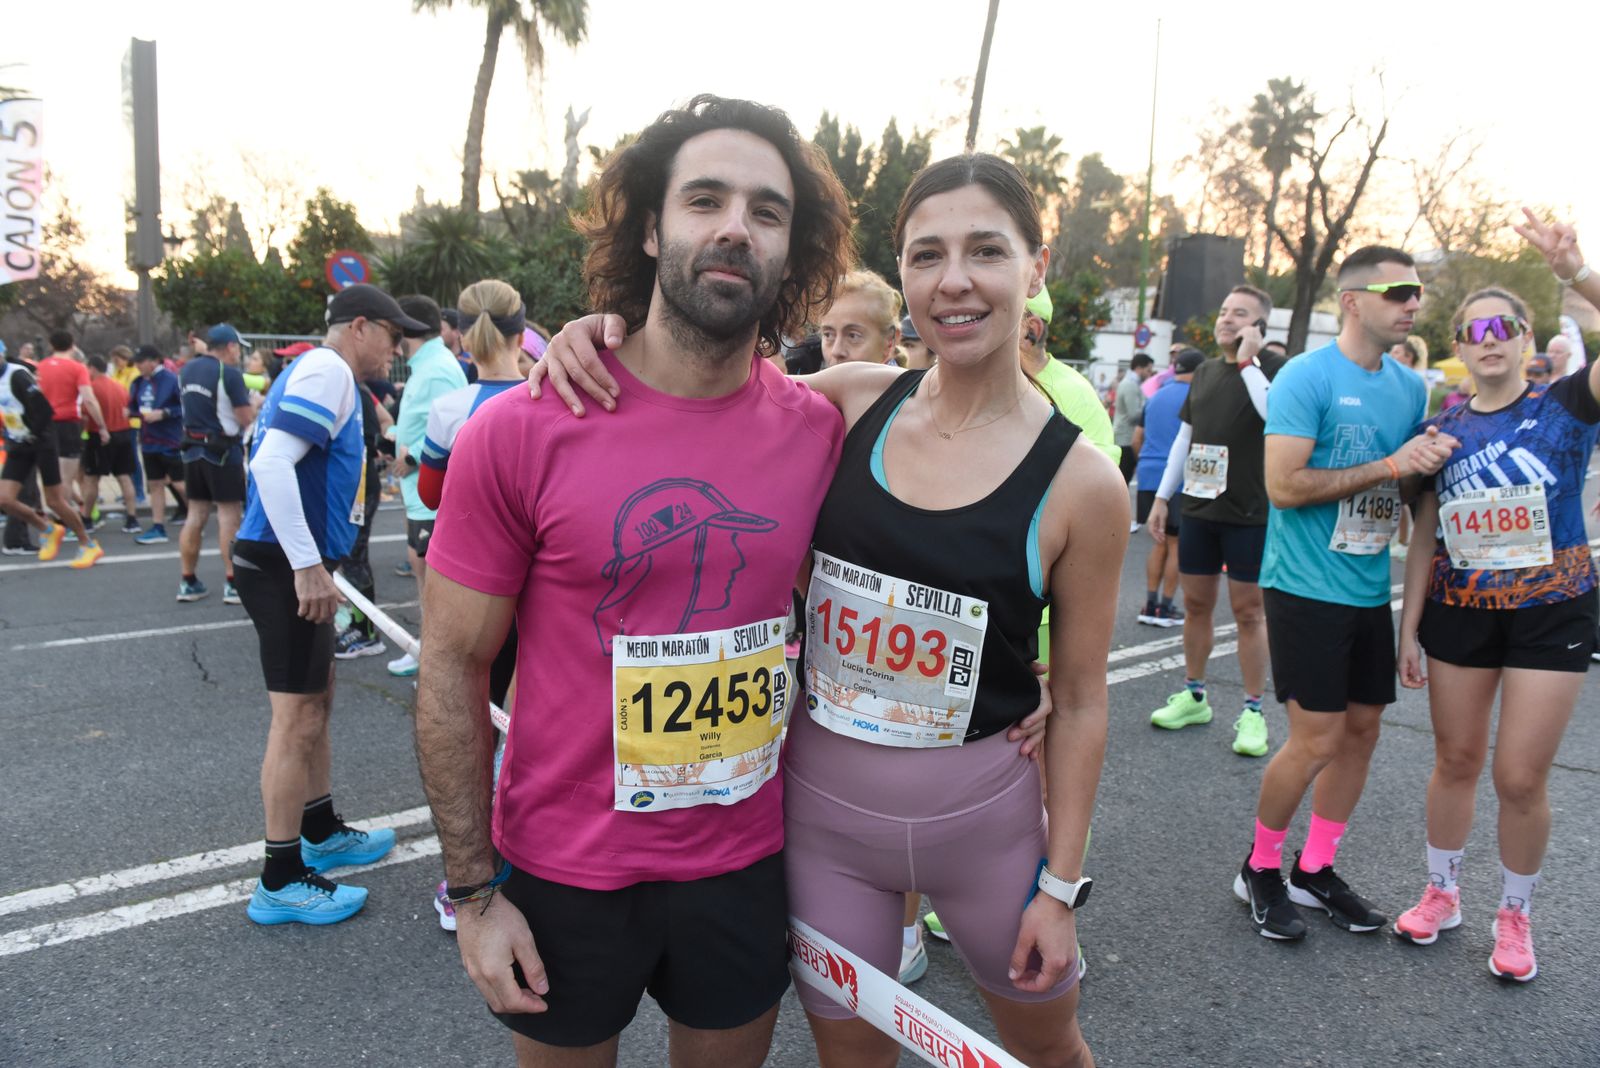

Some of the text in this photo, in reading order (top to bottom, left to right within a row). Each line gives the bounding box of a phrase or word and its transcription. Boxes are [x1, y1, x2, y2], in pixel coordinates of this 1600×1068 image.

[0, 120, 38, 272] CAJÓN 5
[1339, 397, 1362, 406] HOKA
[1334, 423, 1378, 450] FLY
[1442, 439, 1508, 487] MARATÓN
[1347, 494, 1394, 519] 14189
[634, 501, 692, 540] 100 24
[1450, 505, 1531, 535] 14188
[820, 556, 962, 618] MEDIO MARATÓN SEVILLA
[627, 623, 769, 658] MEDIO MARATÓN SEVILLA
[817, 598, 948, 678] 15193
[865, 667, 895, 682] Corina
[632, 667, 772, 733] 12453
[853, 682, 876, 694] Corina
[620, 705, 628, 731] CAJÓN
[852, 718, 880, 733] HOKA
[699, 731, 722, 742] Willy
[703, 787, 731, 797] HOKA
[788, 932, 829, 979] CREAT
[895, 994, 915, 1013] Eventos
[921, 1012, 944, 1032] Creativa
[894, 1009, 963, 1068] CREATE
[943, 1026, 963, 1045] Acción
